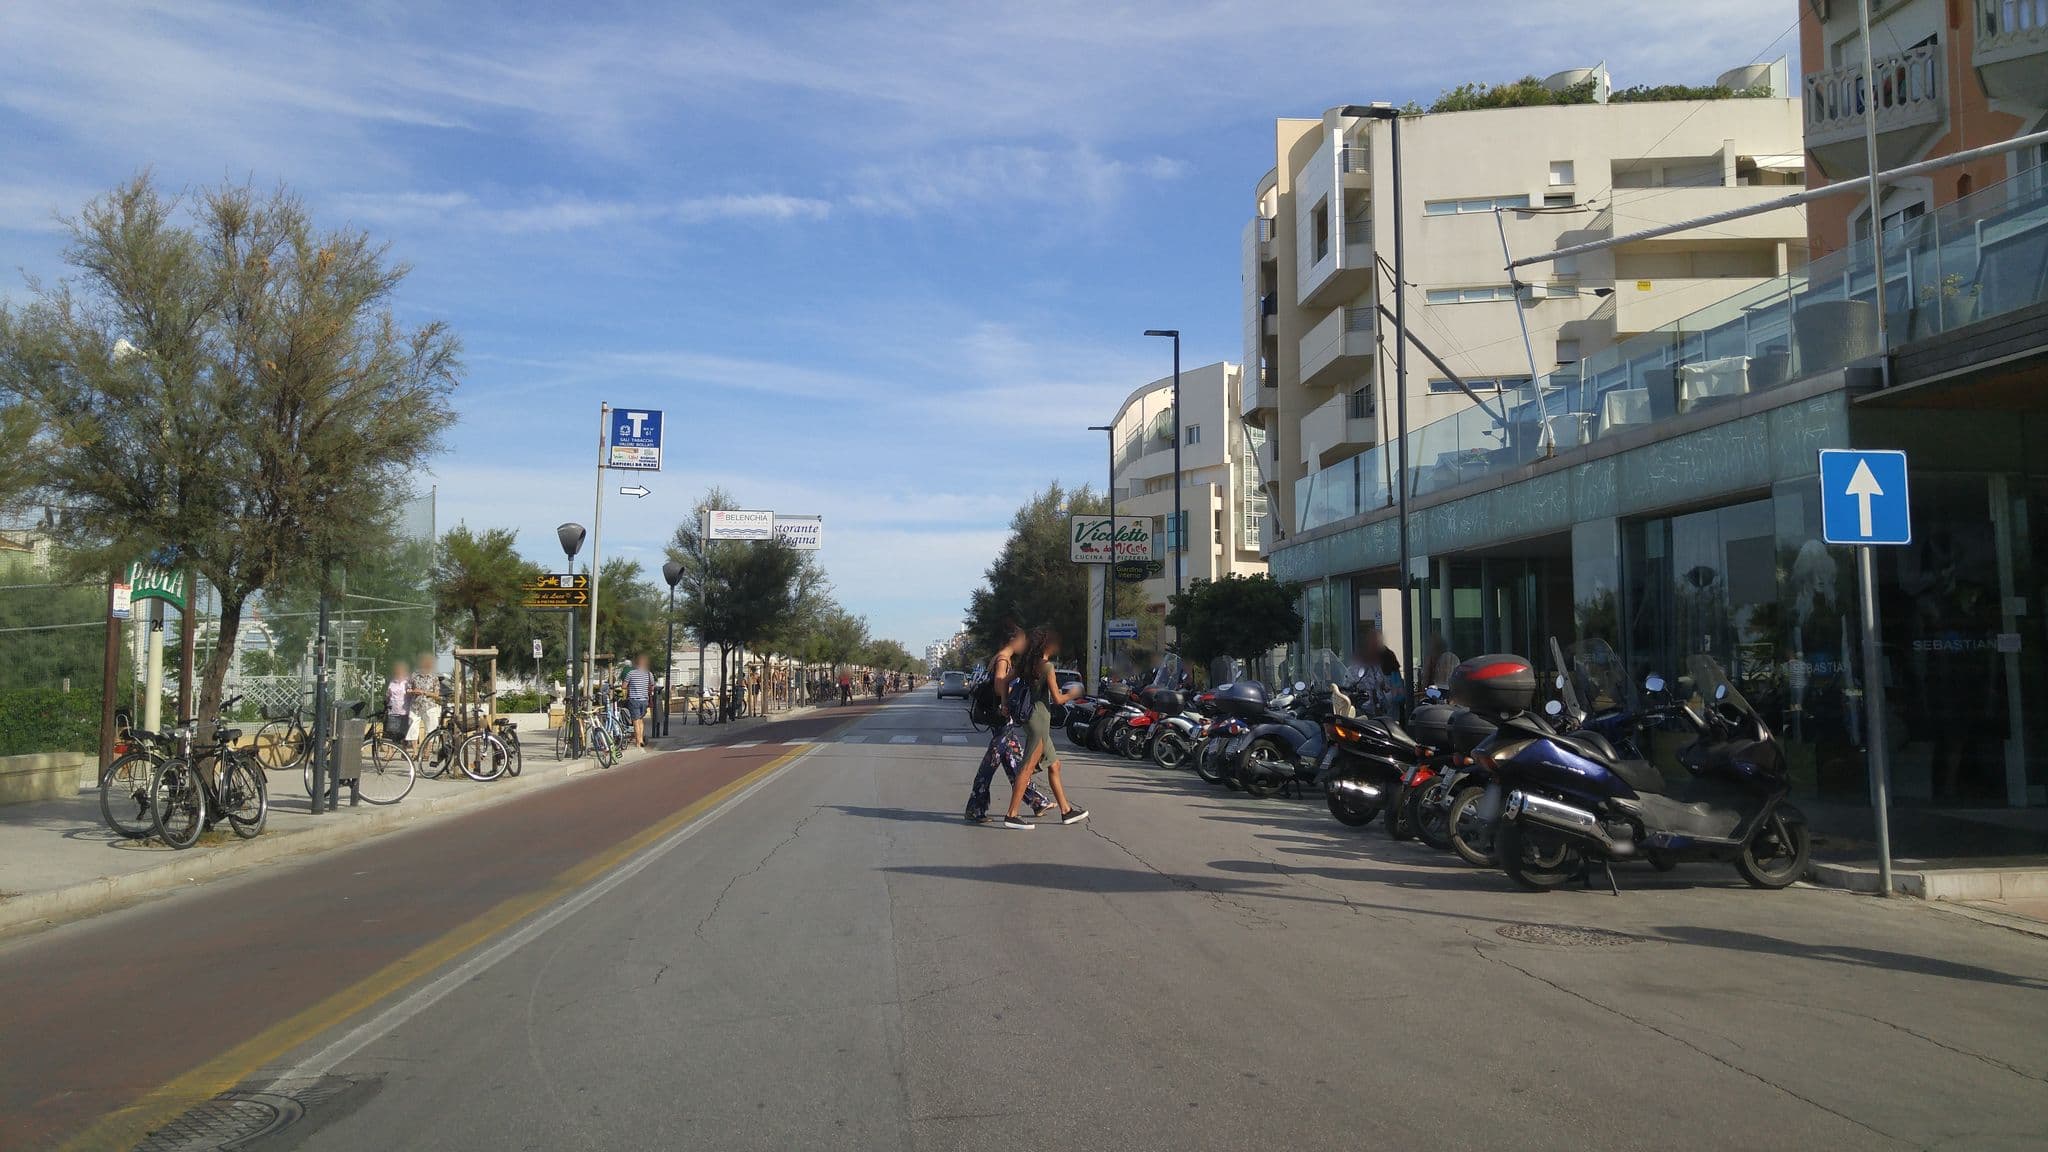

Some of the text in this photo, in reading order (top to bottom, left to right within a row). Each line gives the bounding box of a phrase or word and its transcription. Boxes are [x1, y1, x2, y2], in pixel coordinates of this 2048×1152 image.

[627, 413, 649, 437] T
[725, 514, 768, 522] BELENCHIA
[1075, 520, 1149, 543] Vicoletto
